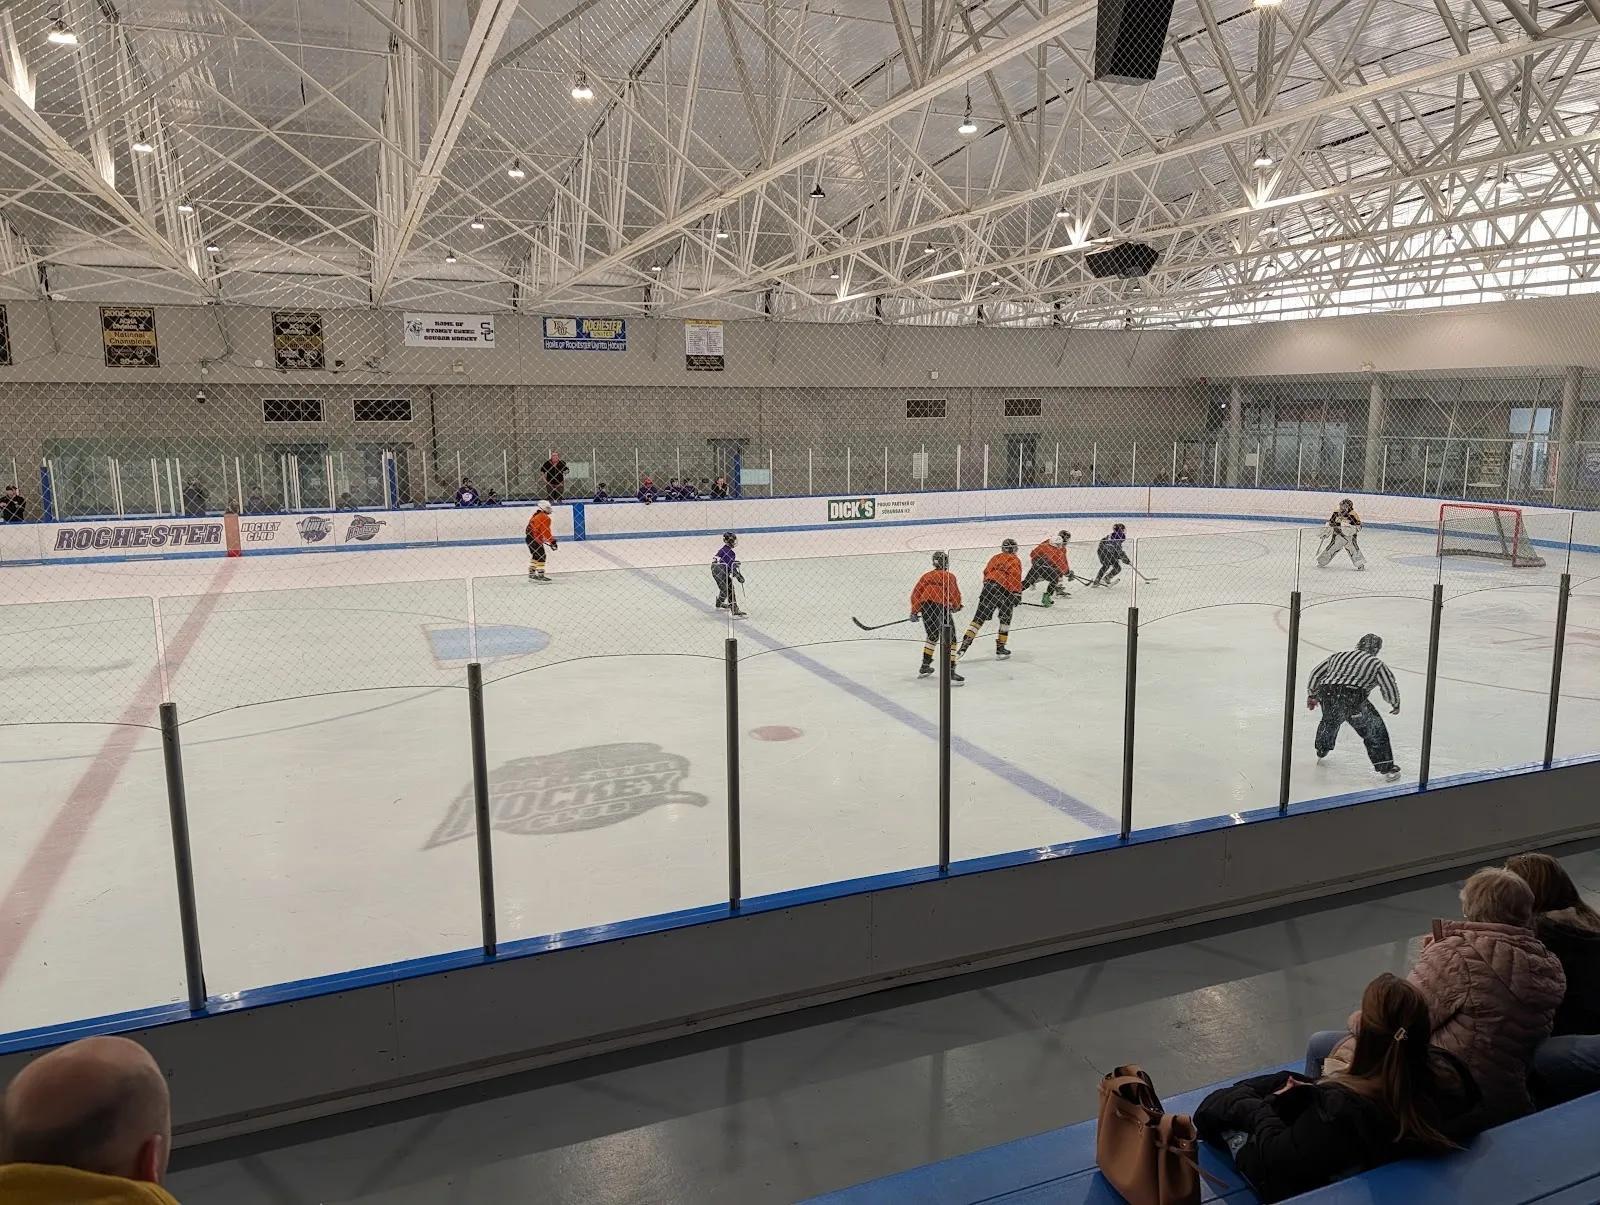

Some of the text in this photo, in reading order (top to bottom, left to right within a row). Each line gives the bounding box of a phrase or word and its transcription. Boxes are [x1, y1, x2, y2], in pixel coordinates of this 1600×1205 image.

[582, 319, 623, 334] ROCHESTER
[545, 340, 559, 349] HOME
[565, 341, 591, 350] ROCHESTER
[591, 341, 607, 351] UNITED
[607, 341, 625, 351] HOCKEY
[830, 500, 874, 519] DICK'S
[241, 521, 281, 532] HOCKEY
[54, 523, 224, 551] ROCHESTER
[246, 531, 275, 542] CLUB
